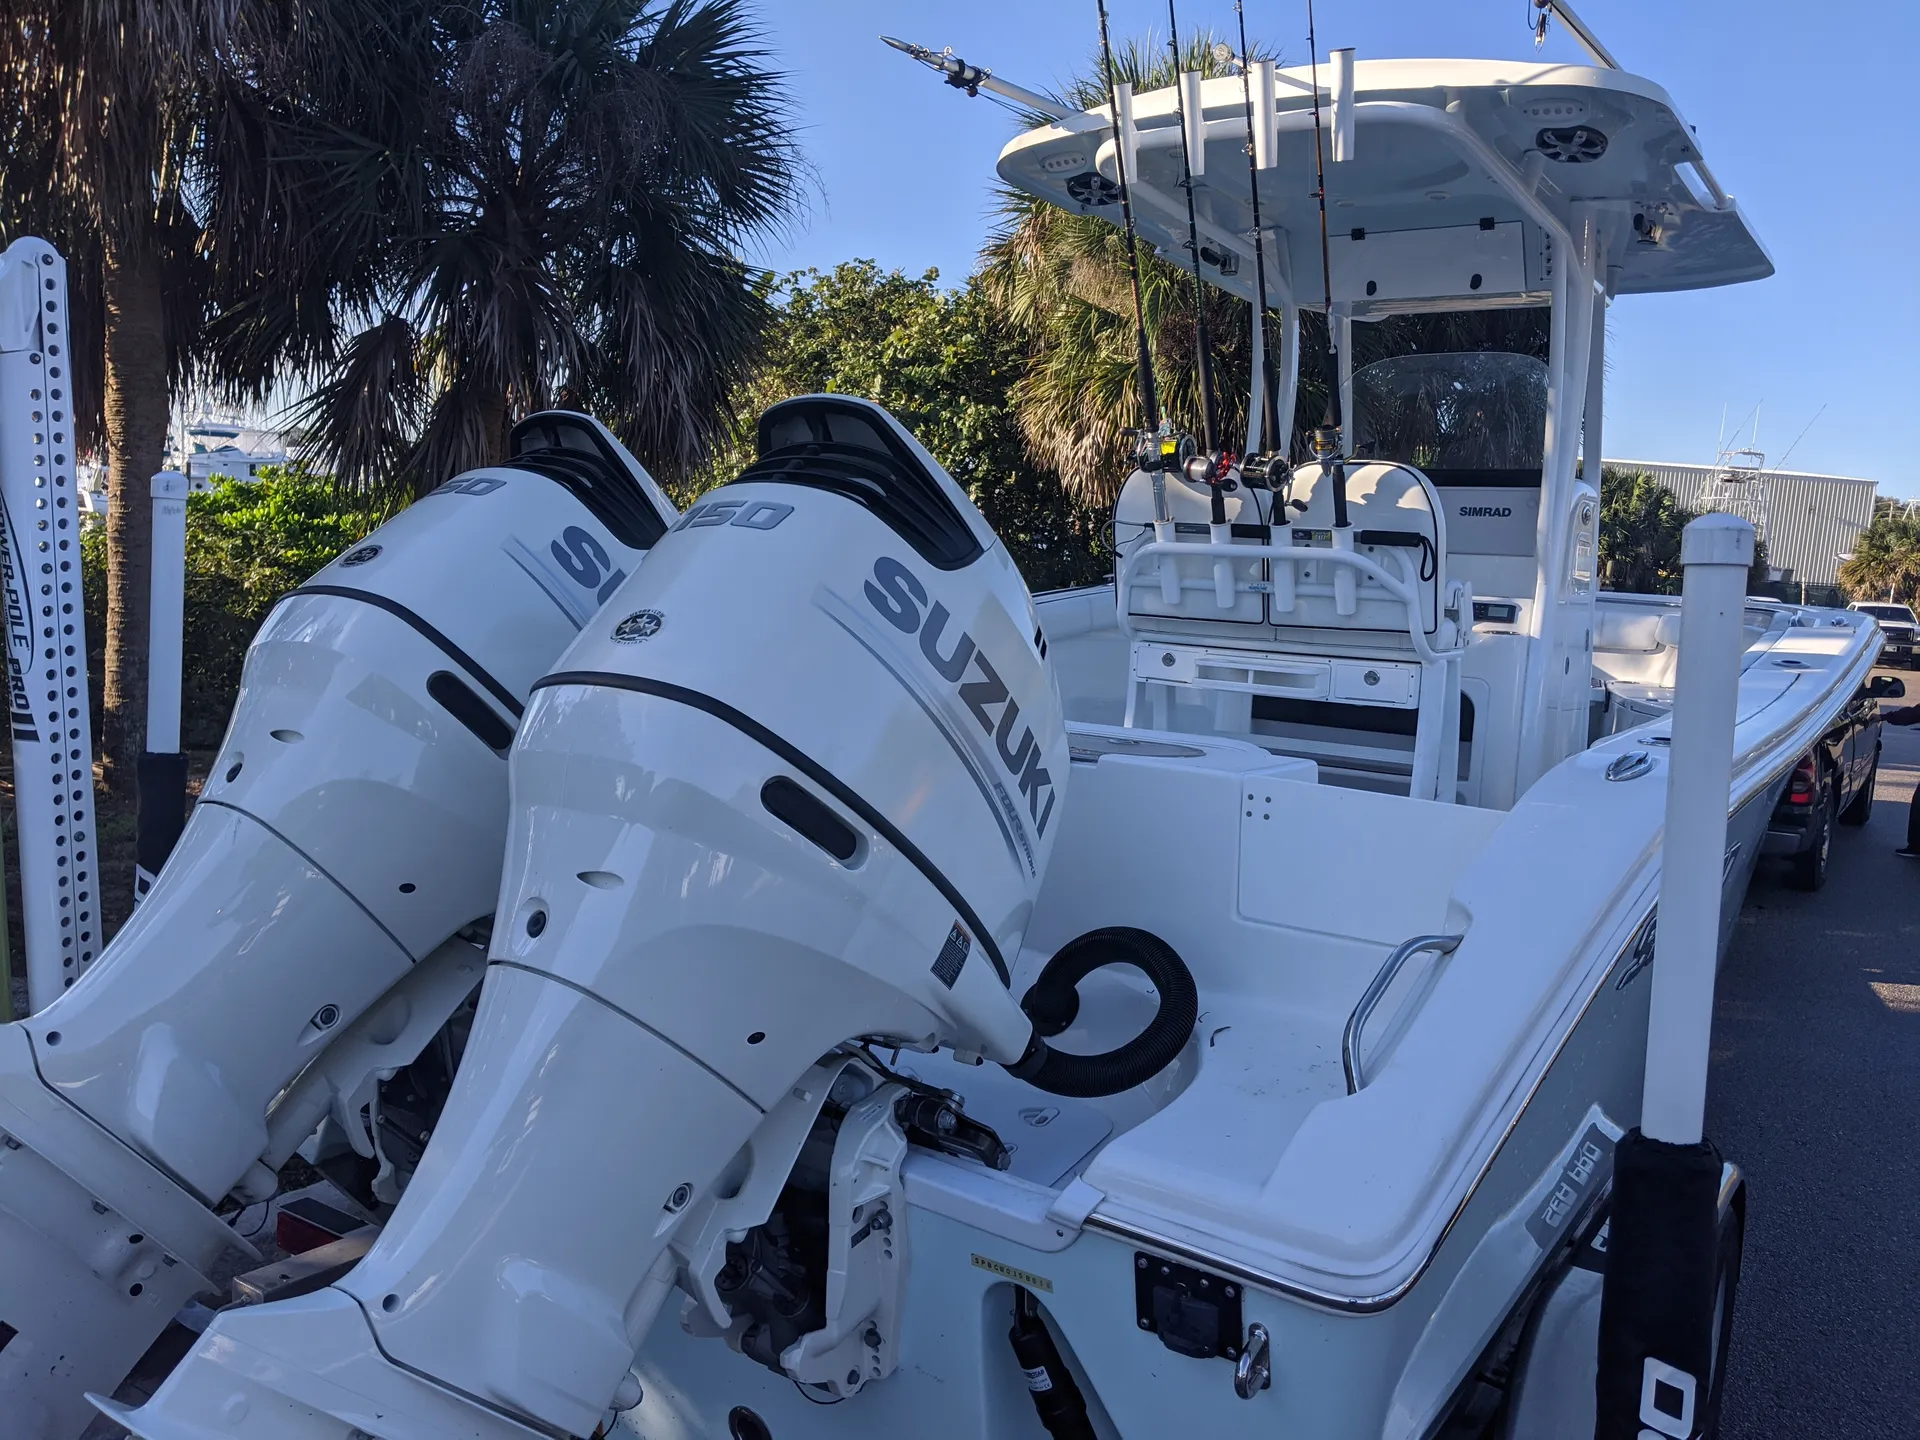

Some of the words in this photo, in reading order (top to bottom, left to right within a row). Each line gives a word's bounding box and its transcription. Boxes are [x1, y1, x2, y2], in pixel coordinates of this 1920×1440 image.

[672, 500, 795, 533] 150
[1459, 506, 1512, 517] SIMRAD
[863, 556, 1056, 841] SUZUKI
